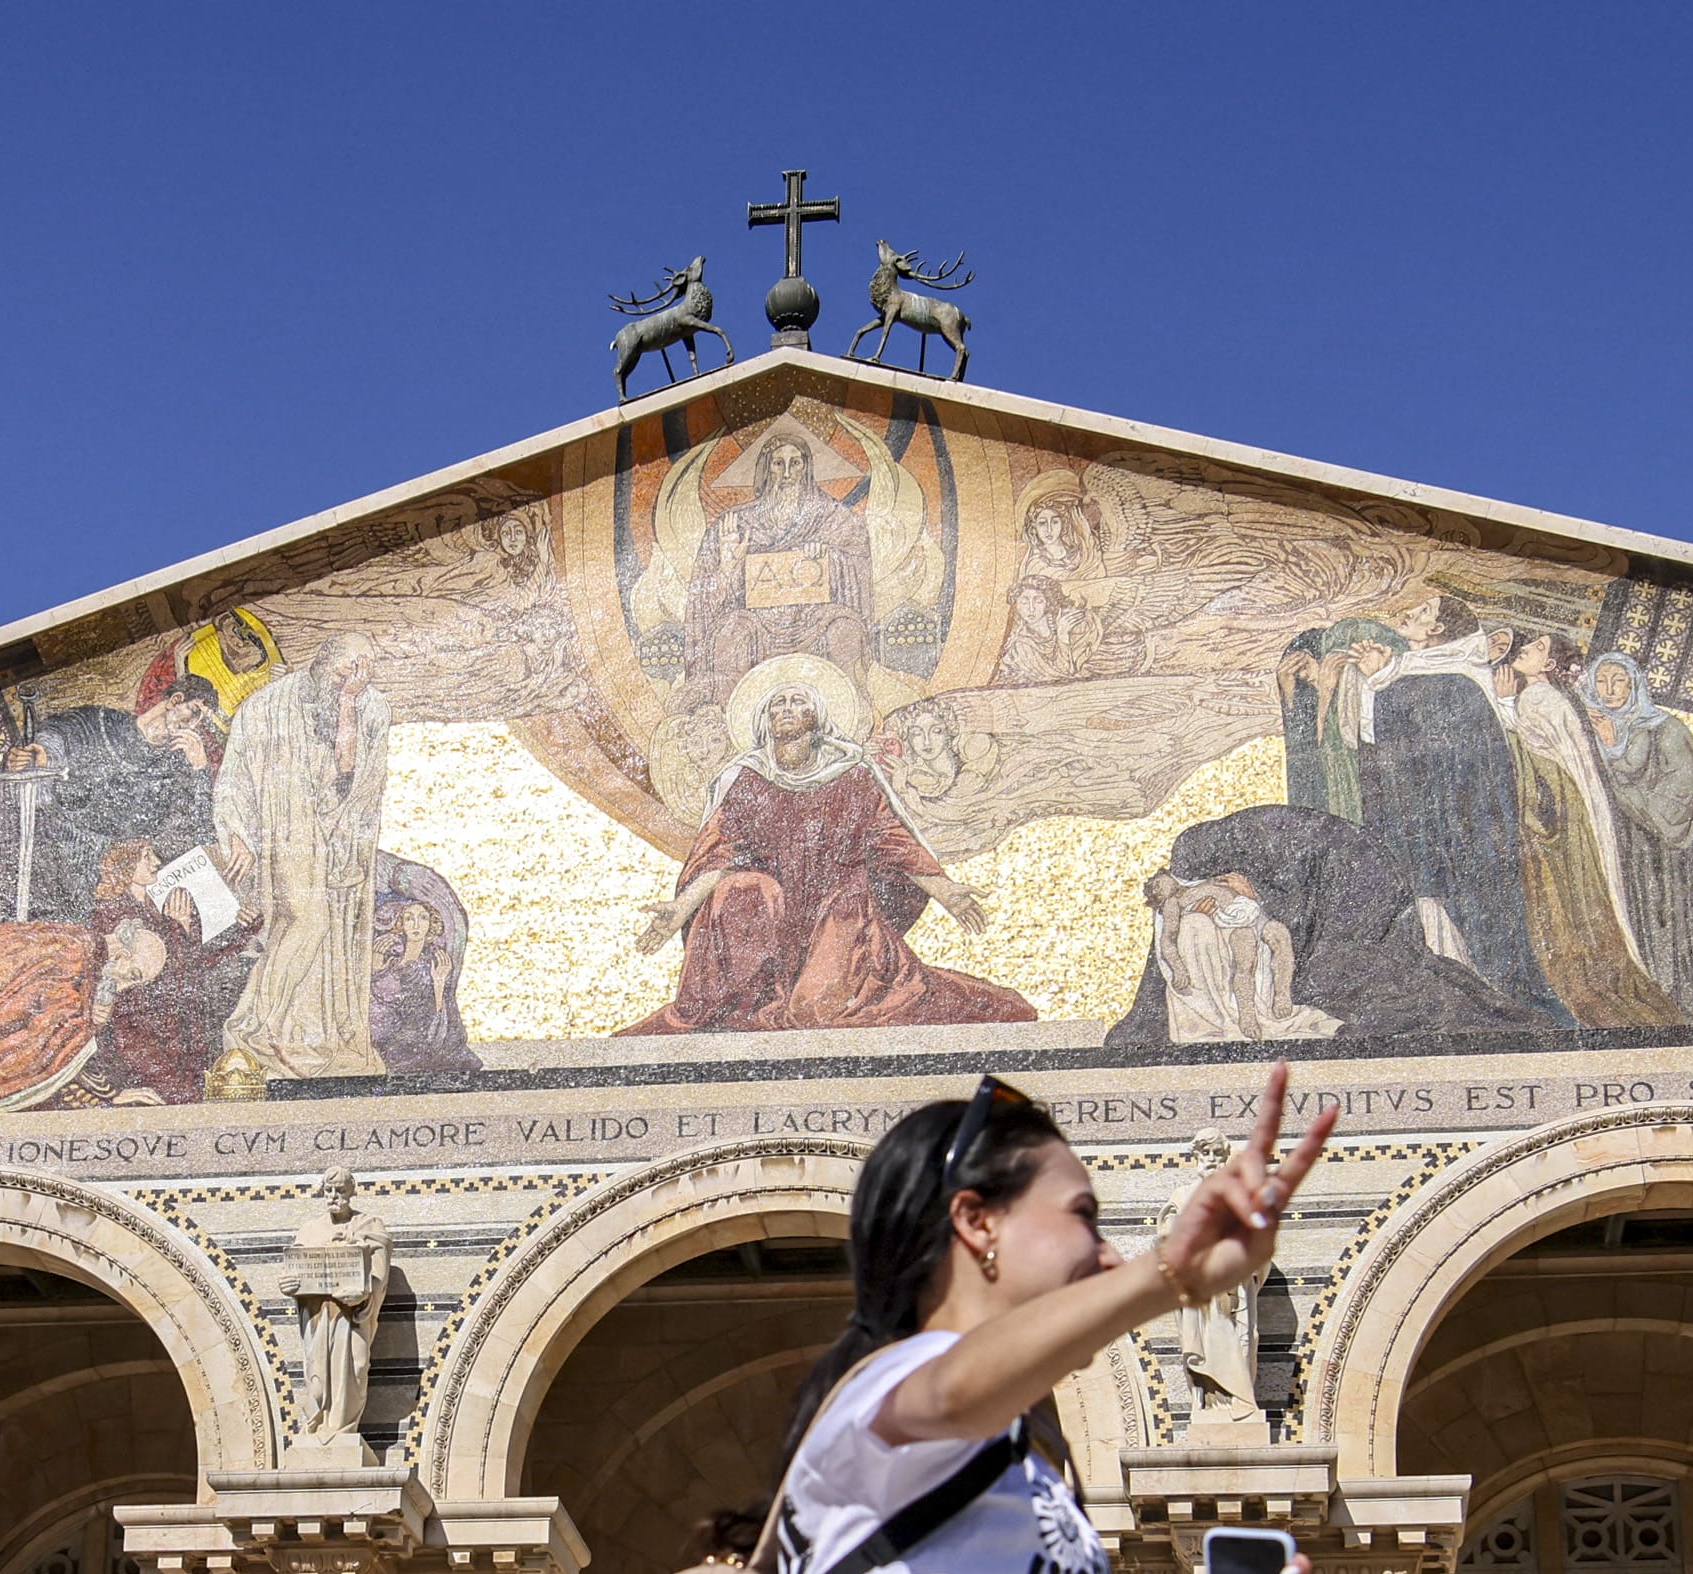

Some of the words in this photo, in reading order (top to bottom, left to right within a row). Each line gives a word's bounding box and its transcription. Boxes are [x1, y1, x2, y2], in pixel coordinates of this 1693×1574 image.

[147, 854, 207, 899] IGNORATIO
[215, 1131, 287, 1155] CVM
[313, 1122, 486, 1152] CLAMORE
[516, 1115, 649, 1144] VALIDO
[676, 1112, 724, 1138] ET
[752, 1105, 913, 1135] LACRYM
[1049, 1096, 1178, 1126] ERENS
[1209, 1089, 1434, 1119] EXVDITVS
[1465, 1085, 1544, 1111] EST
[1575, 1081, 1656, 1108] PRO
